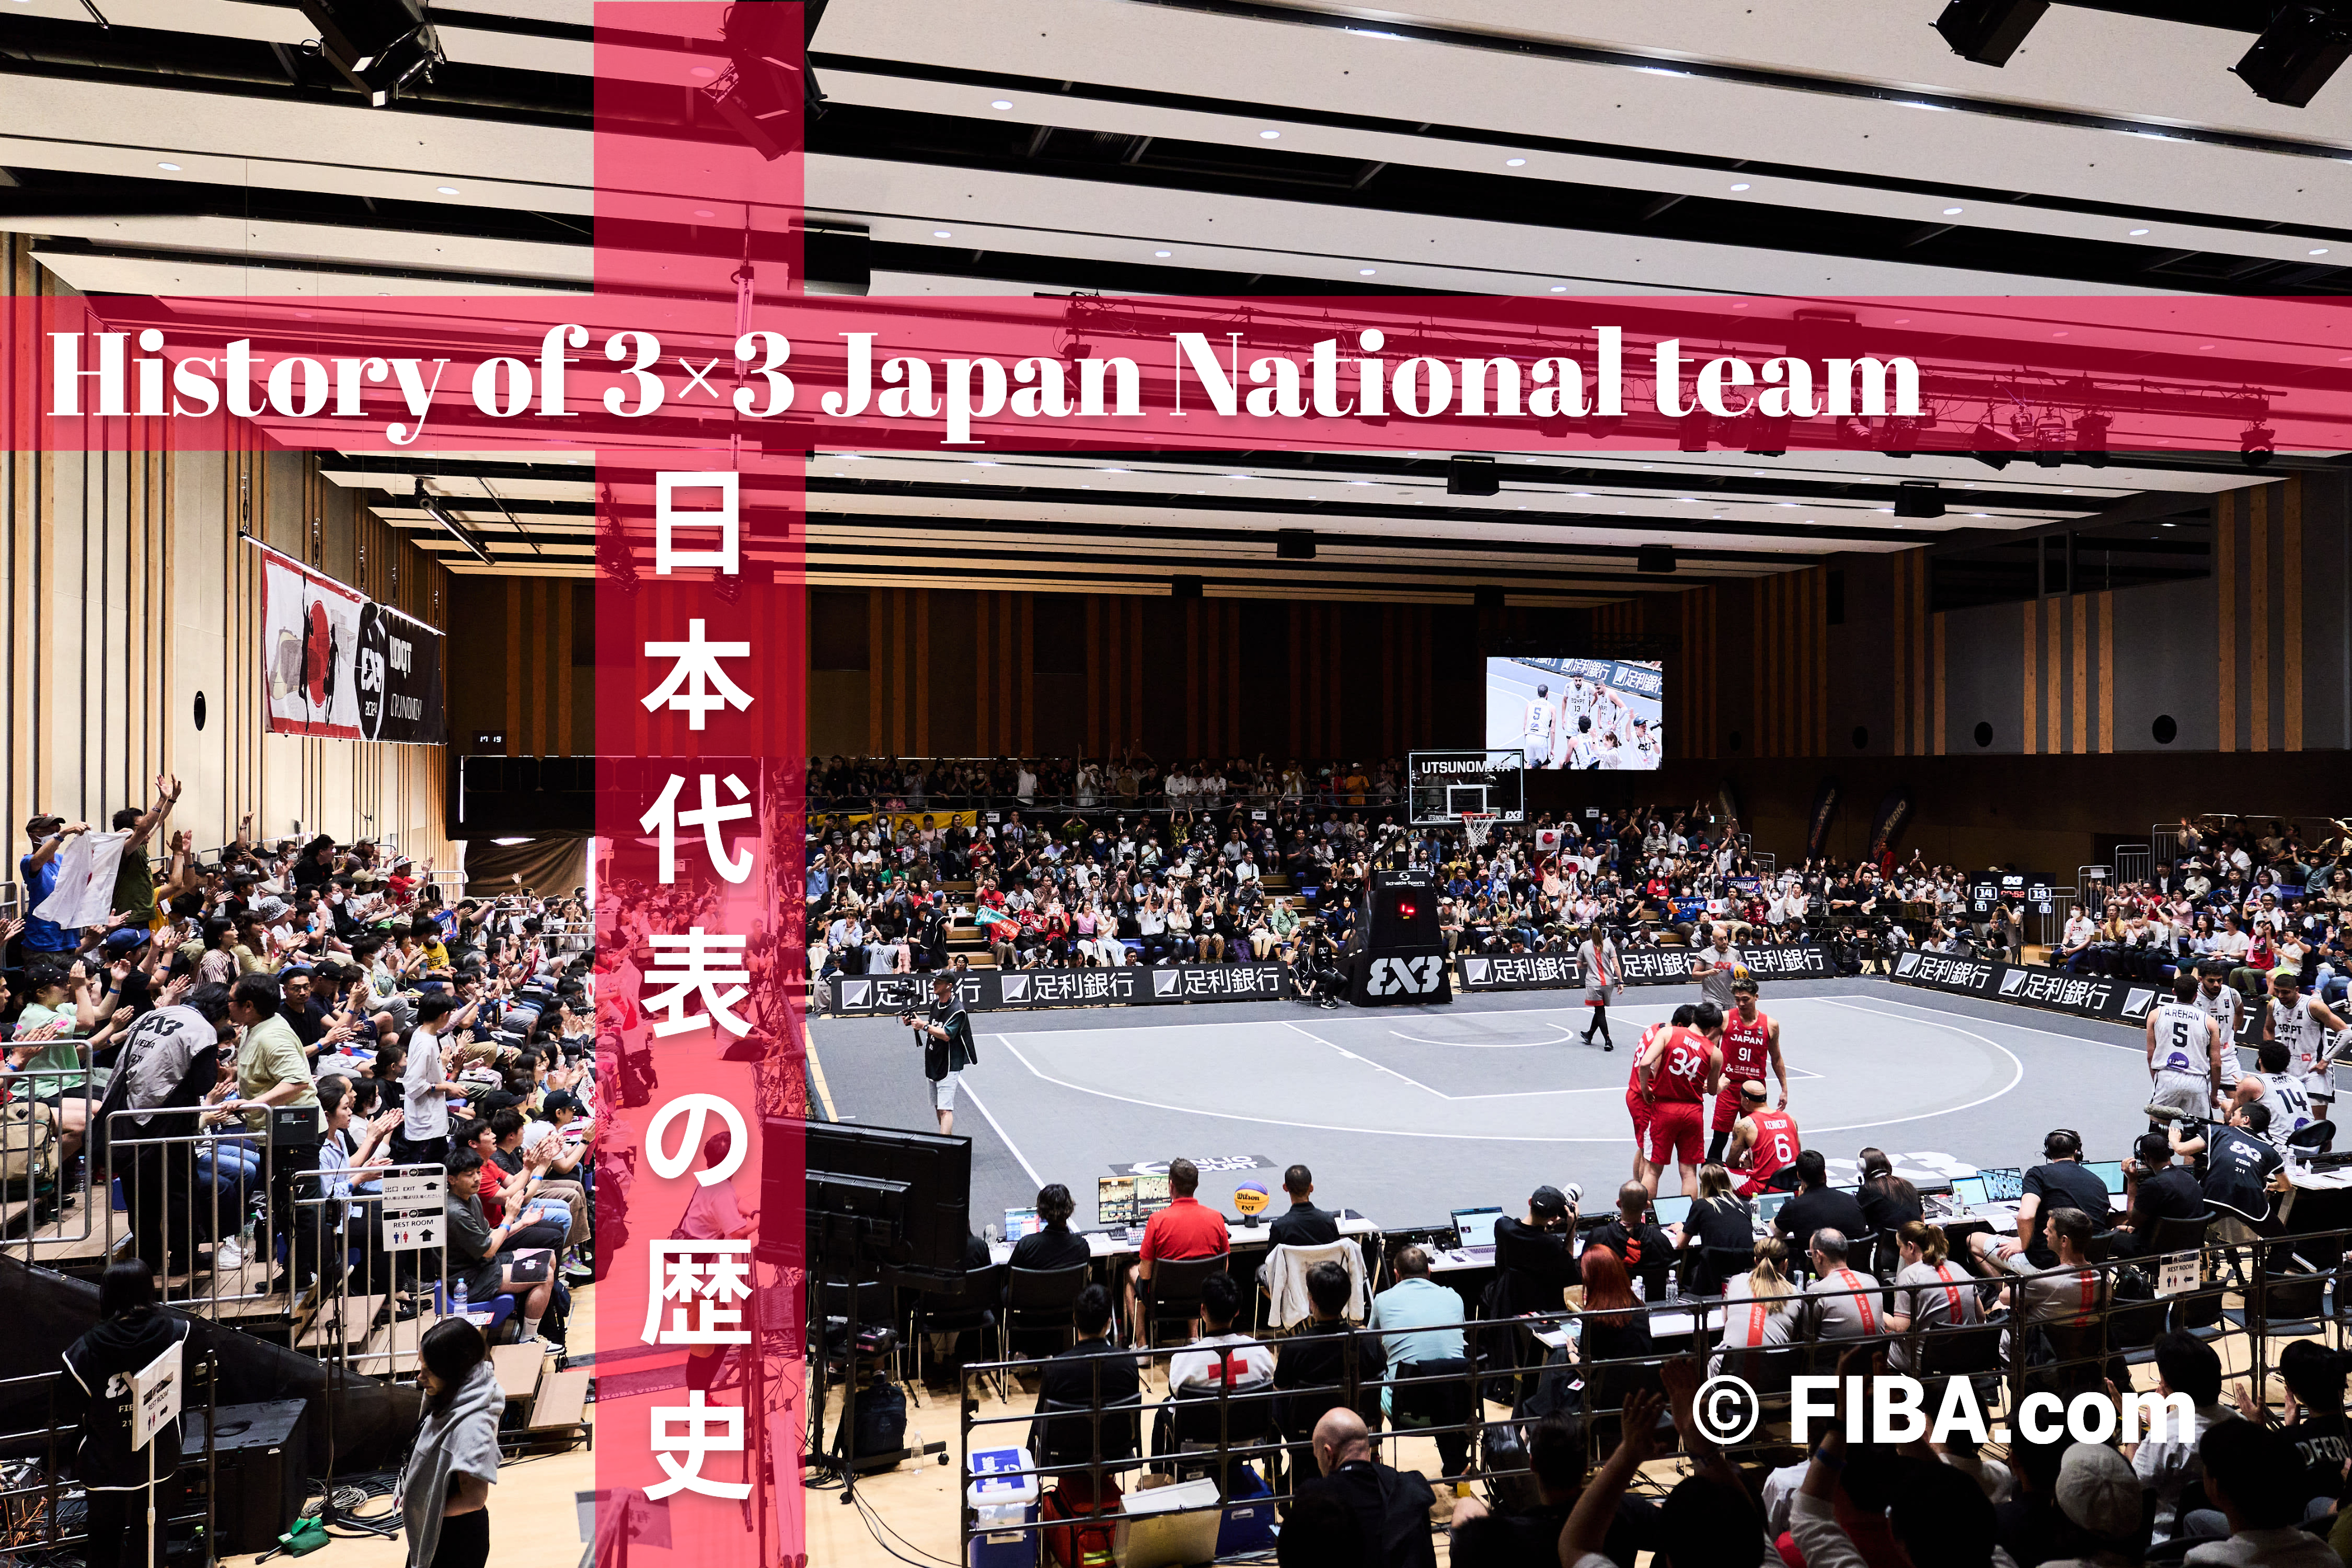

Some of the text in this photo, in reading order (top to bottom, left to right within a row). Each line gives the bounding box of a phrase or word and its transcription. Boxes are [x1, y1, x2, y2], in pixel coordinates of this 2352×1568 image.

[1533, 707, 1541, 720] 5
[1979, 888, 1993, 898] 14
[1493, 957, 1580, 982] 足利銀行
[1744, 948, 1824, 973] 足利銀行
[1184, 967, 1280, 994] 足利銀行
[1915, 956, 1993, 989] 足利銀行
[1034, 972, 1134, 1001] 足利銀行
[2022, 973, 2112, 1011] 足利銀行
[2164, 1008, 2200, 1021] A.REHAN
[1730, 1034, 1763, 1045] JAPAN
[2171, 1022, 2188, 1048] 5
[1738, 1047, 1752, 1062] 91
[1668, 1047, 1701, 1082] 34
[2276, 1088, 2307, 1114] 14
[1763, 1119, 1788, 1130] KENNEDY
[1774, 1133, 1792, 1163] 6
[1190, 1155, 1253, 1166] NLIO
[1197, 1161, 1258, 1171] OURT
[2235, 1157, 2251, 1167] FIBA
[412, 1219, 434, 1227] ROOM
[1853, 1285, 1863, 1299] YU
[1753, 1306, 1762, 1330] COURT
